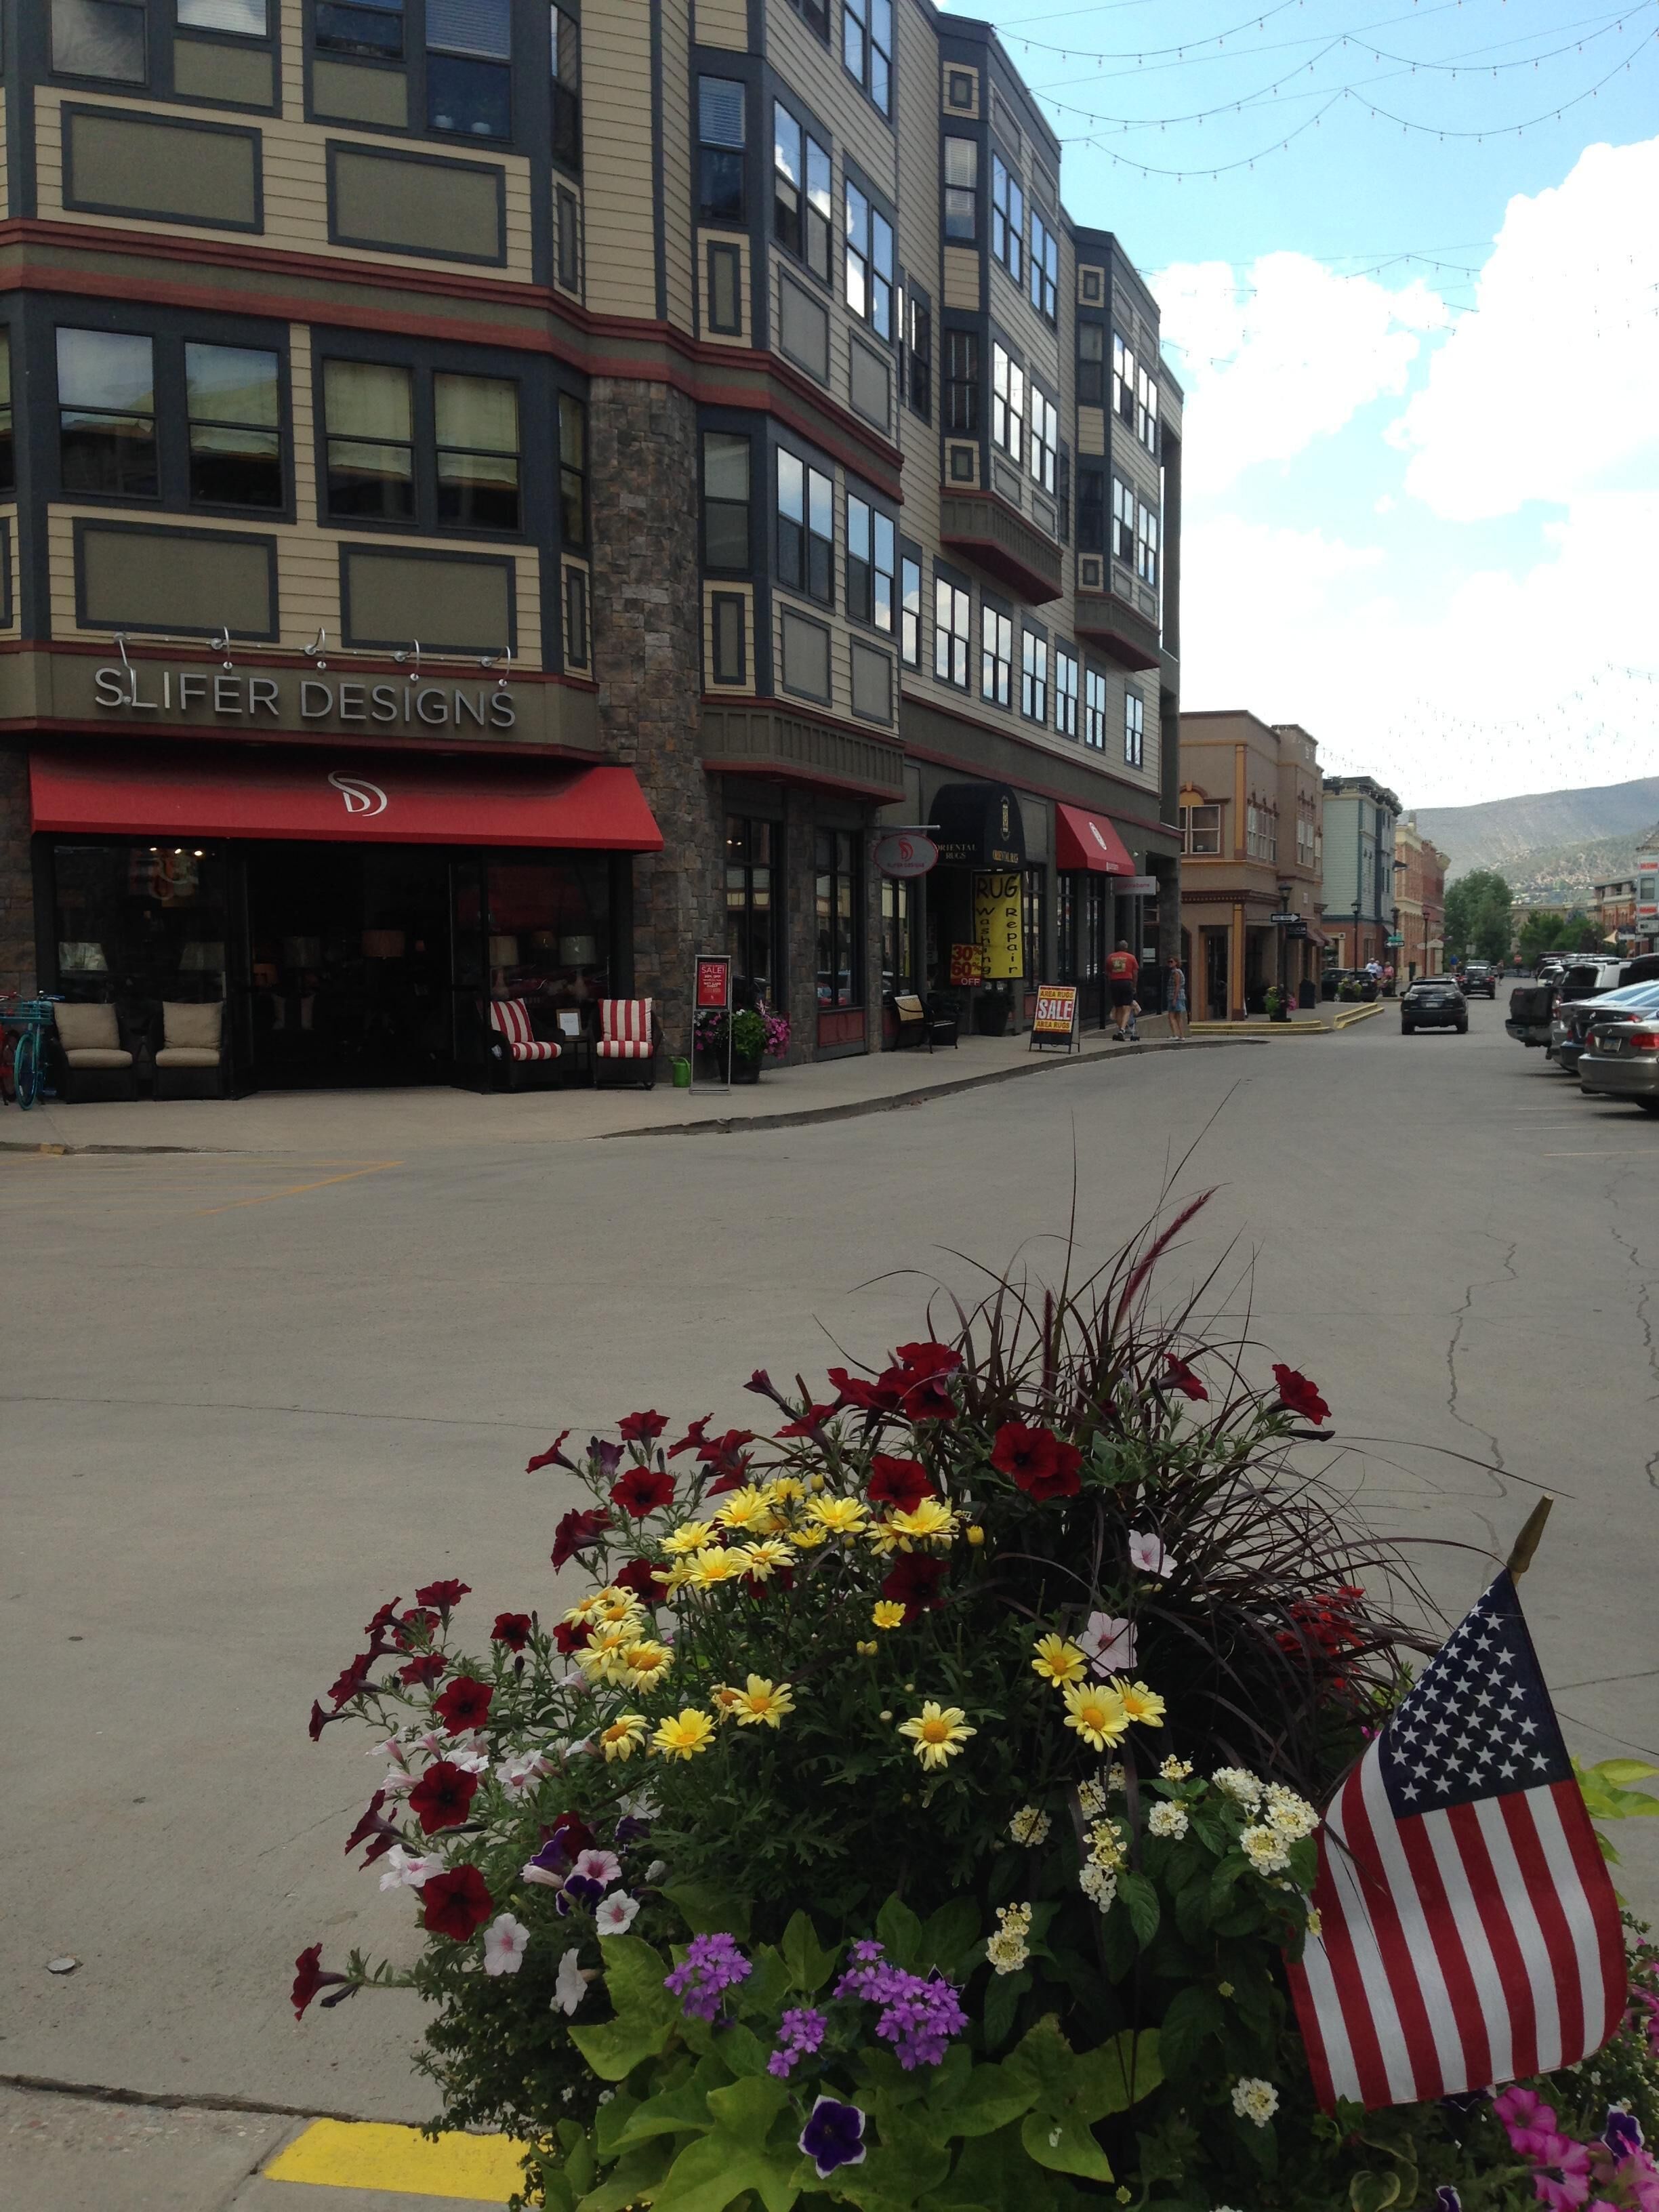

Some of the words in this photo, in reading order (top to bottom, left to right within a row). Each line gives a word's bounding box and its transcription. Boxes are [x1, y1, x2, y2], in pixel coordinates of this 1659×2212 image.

[95, 668, 279, 715] SLIFER
[301, 680, 516, 727] DESIGNS
[977, 876, 1019, 899] RUG
[951, 945, 983, 960] 30%
[951, 962, 982, 976] 60%
[961, 977, 981, 985] OFF
[1038, 999, 1072, 1020] SALE
